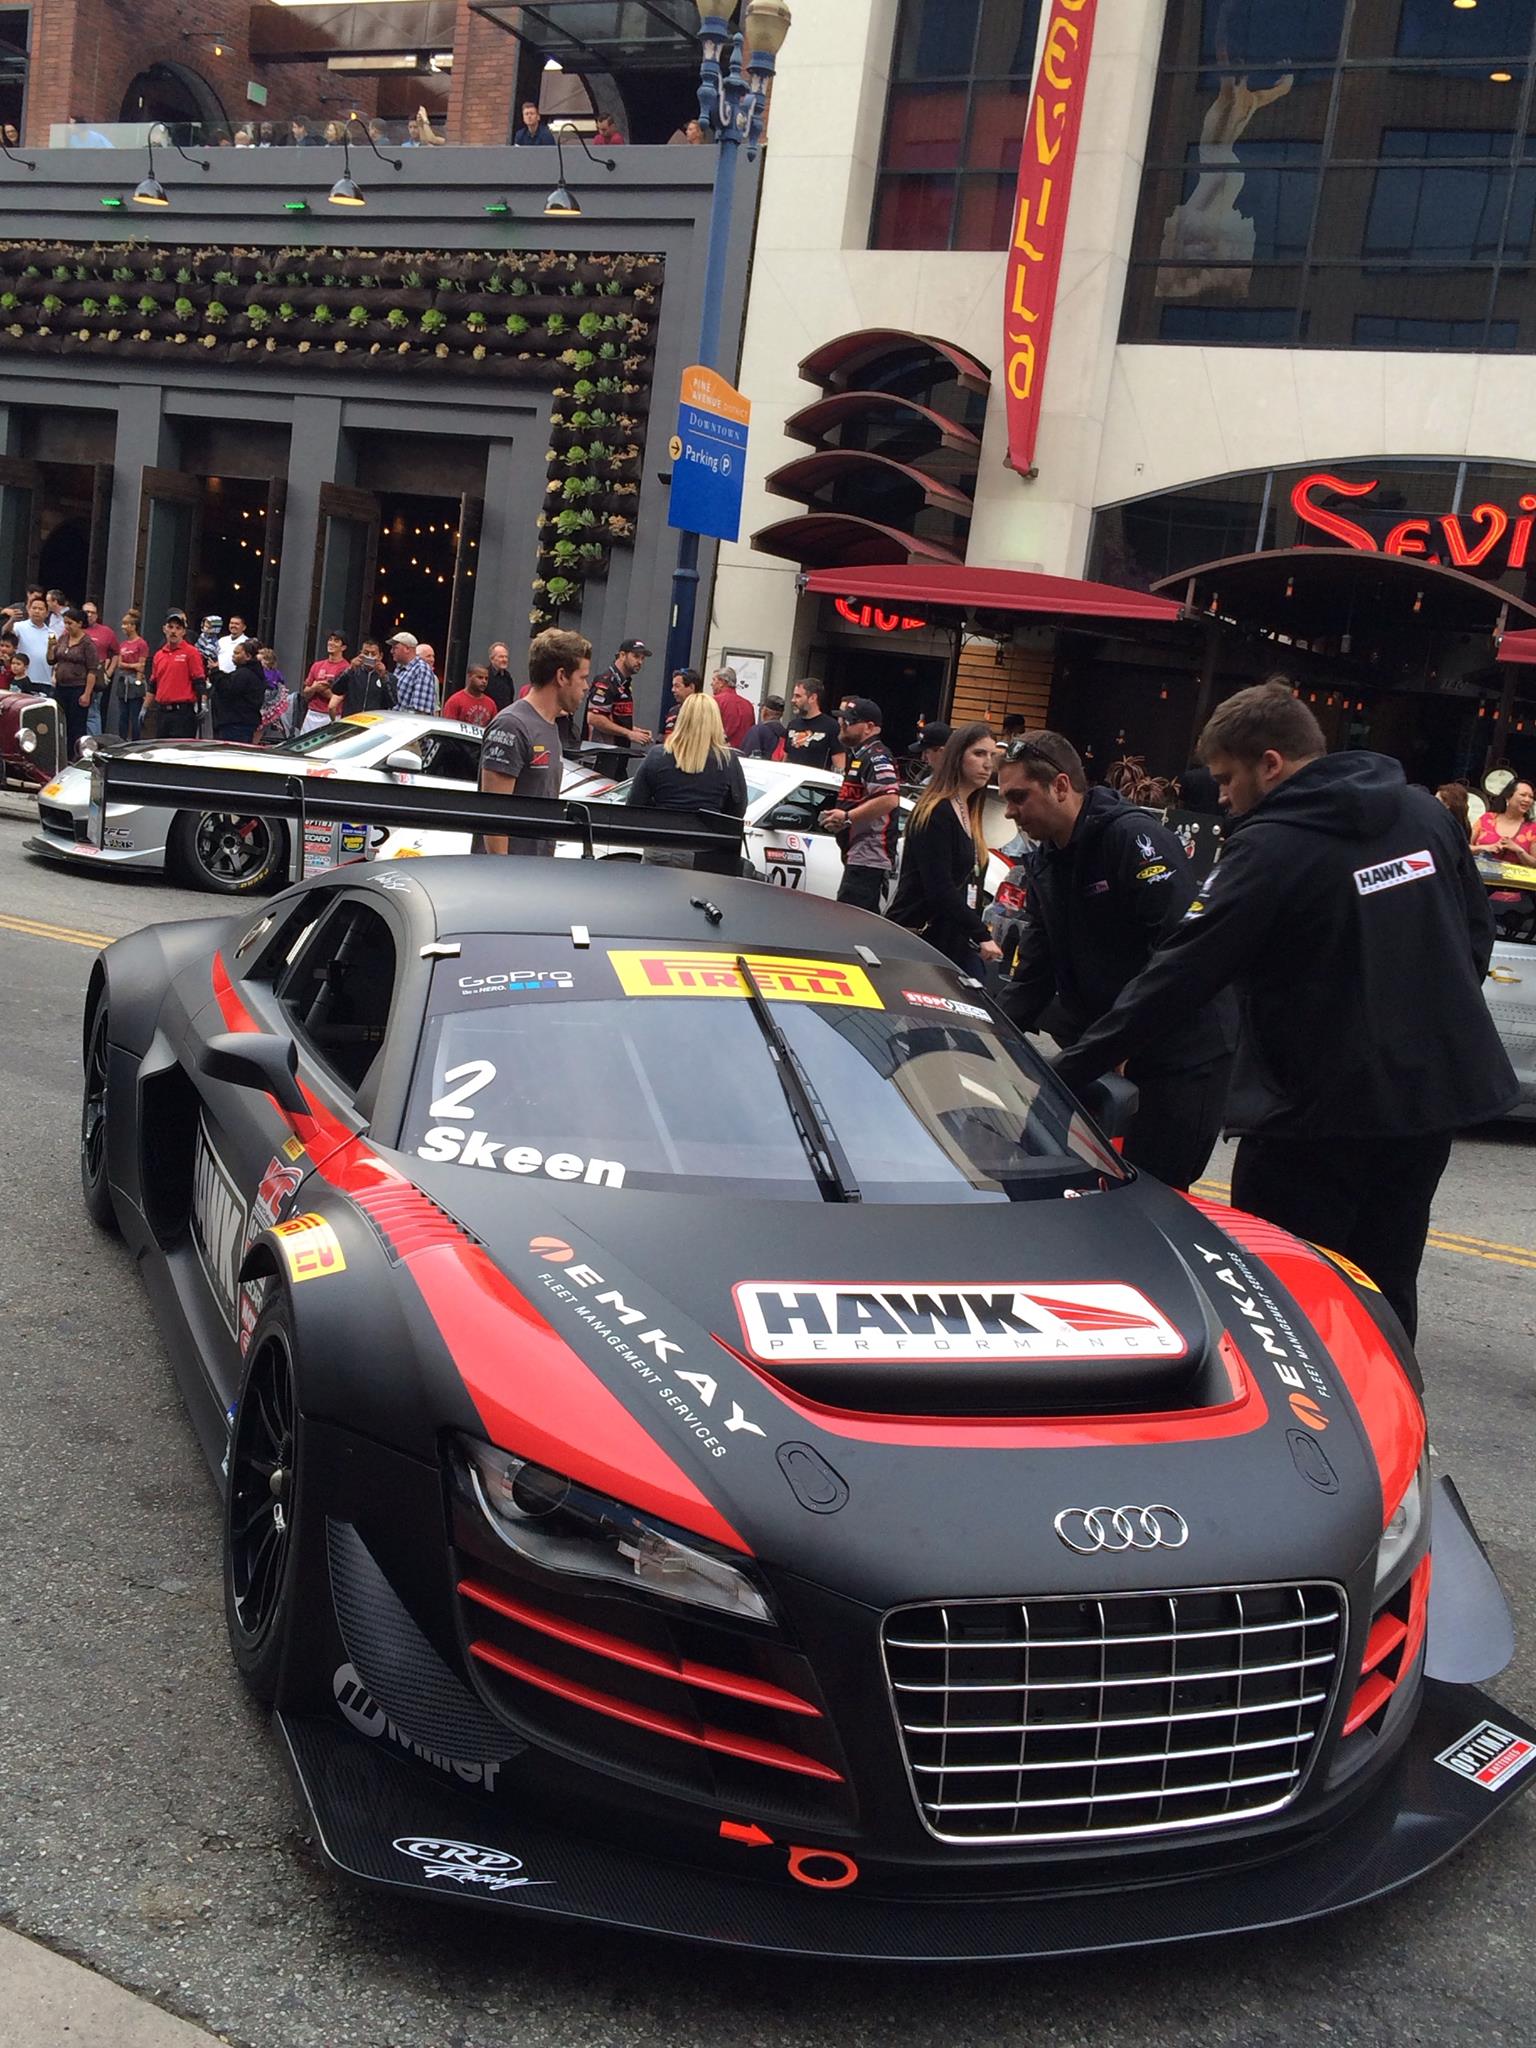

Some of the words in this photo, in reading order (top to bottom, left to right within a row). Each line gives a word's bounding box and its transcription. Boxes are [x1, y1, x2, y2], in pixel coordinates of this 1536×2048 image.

[692, 378, 711, 393] PINE
[692, 390, 721, 409] AVENUE
[685, 445, 719, 473] Parking
[304, 835, 331, 843] ECARO
[1359, 860, 1409, 888] HAWK
[459, 971, 573, 988] GoPro
[640, 959, 854, 996] PIRELLI
[429, 1060, 496, 1120] 2
[417, 1126, 626, 1189] Skeen
[755, 1291, 1044, 1335] HAWK
[1193, 1243, 1306, 1391] EMKAY
[1258, 1292, 1310, 1361] MANAGEMENT
[563, 1263, 768, 1438] EMKAY
[770, 1335, 1172, 1351] PERFORMANCE
[537, 1272, 578, 1304] FLEET
[573, 1304, 663, 1385] MANAGEMENT
[658, 1387, 727, 1458] SERVICES
[1302, 1361, 1331, 1398] FLEET
[1449, 1729, 1513, 1774] OPTIMA
[408, 1842, 511, 1866] CRP
[423, 1865, 558, 1891] Racing
